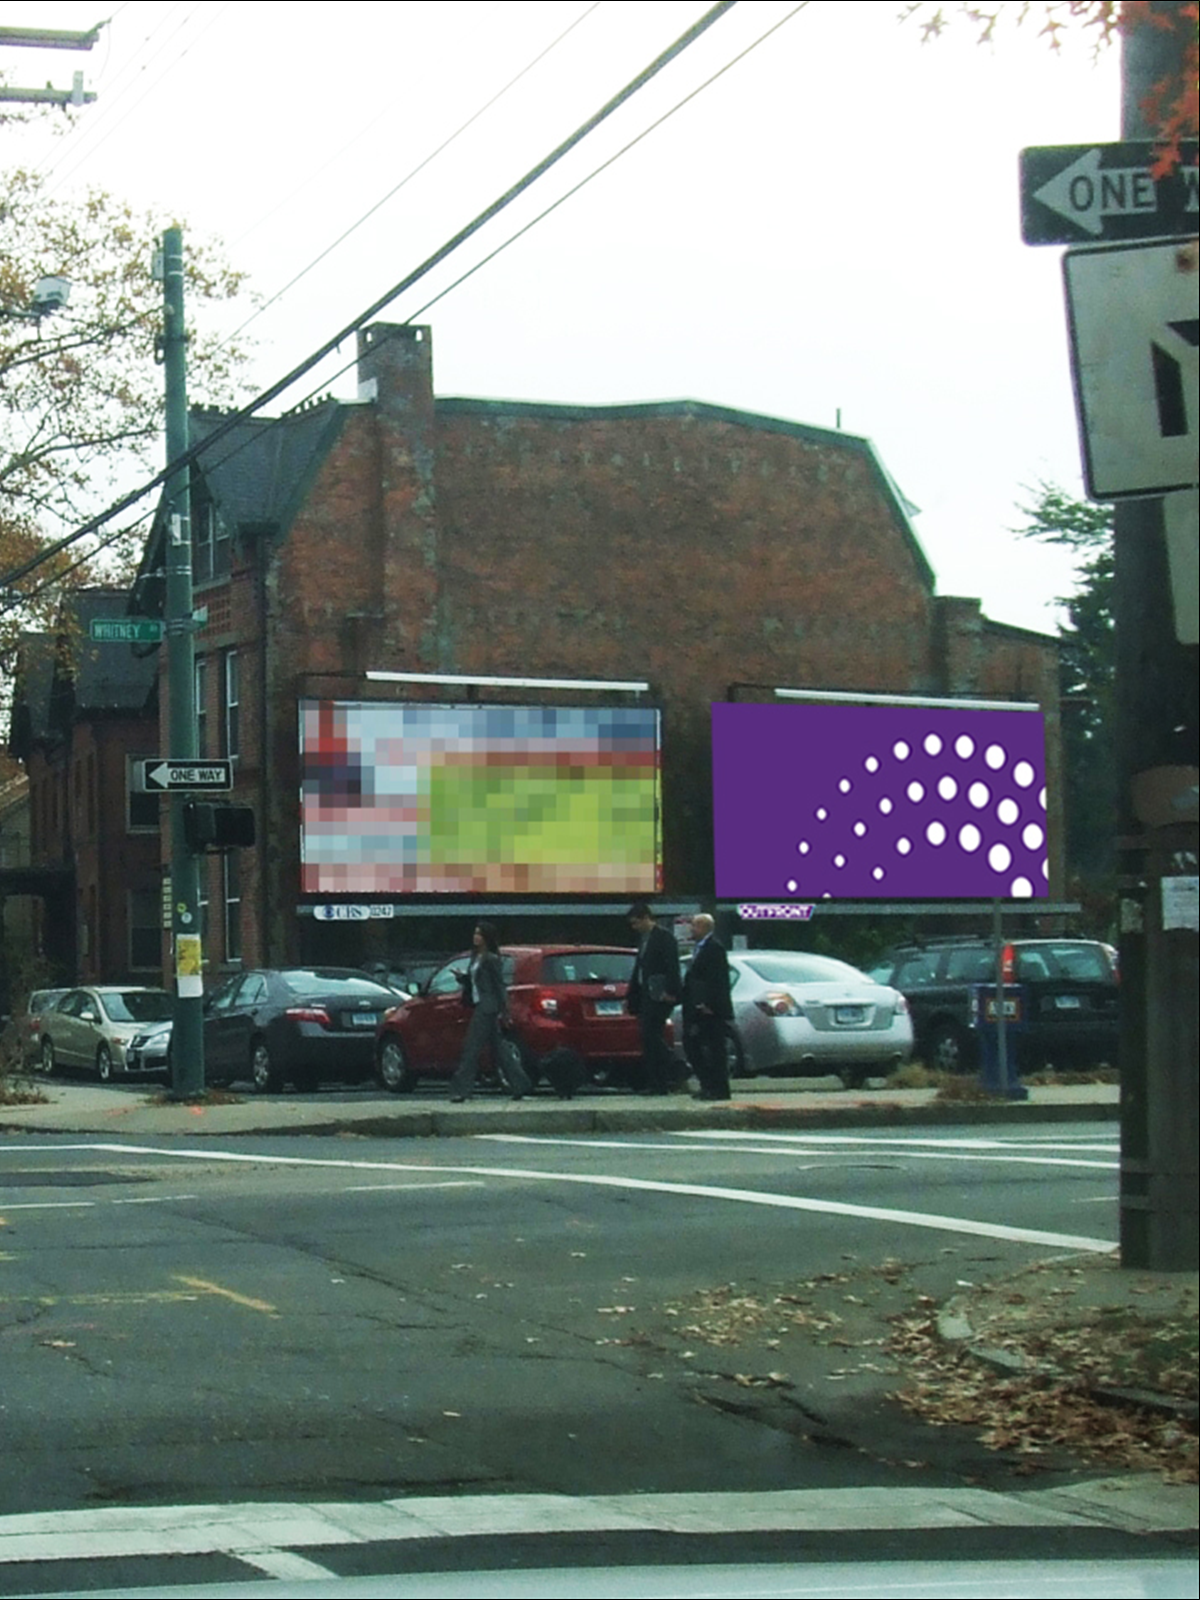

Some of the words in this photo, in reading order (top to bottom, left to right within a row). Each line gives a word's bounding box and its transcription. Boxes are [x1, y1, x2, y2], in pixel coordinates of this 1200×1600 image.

[1069, 173, 1154, 212] ONE
[95, 623, 139, 638] WHITNEY
[170, 769, 195, 781] ONE
[198, 769, 221, 780] WAY
[740, 904, 811, 919] OUTFRONT
